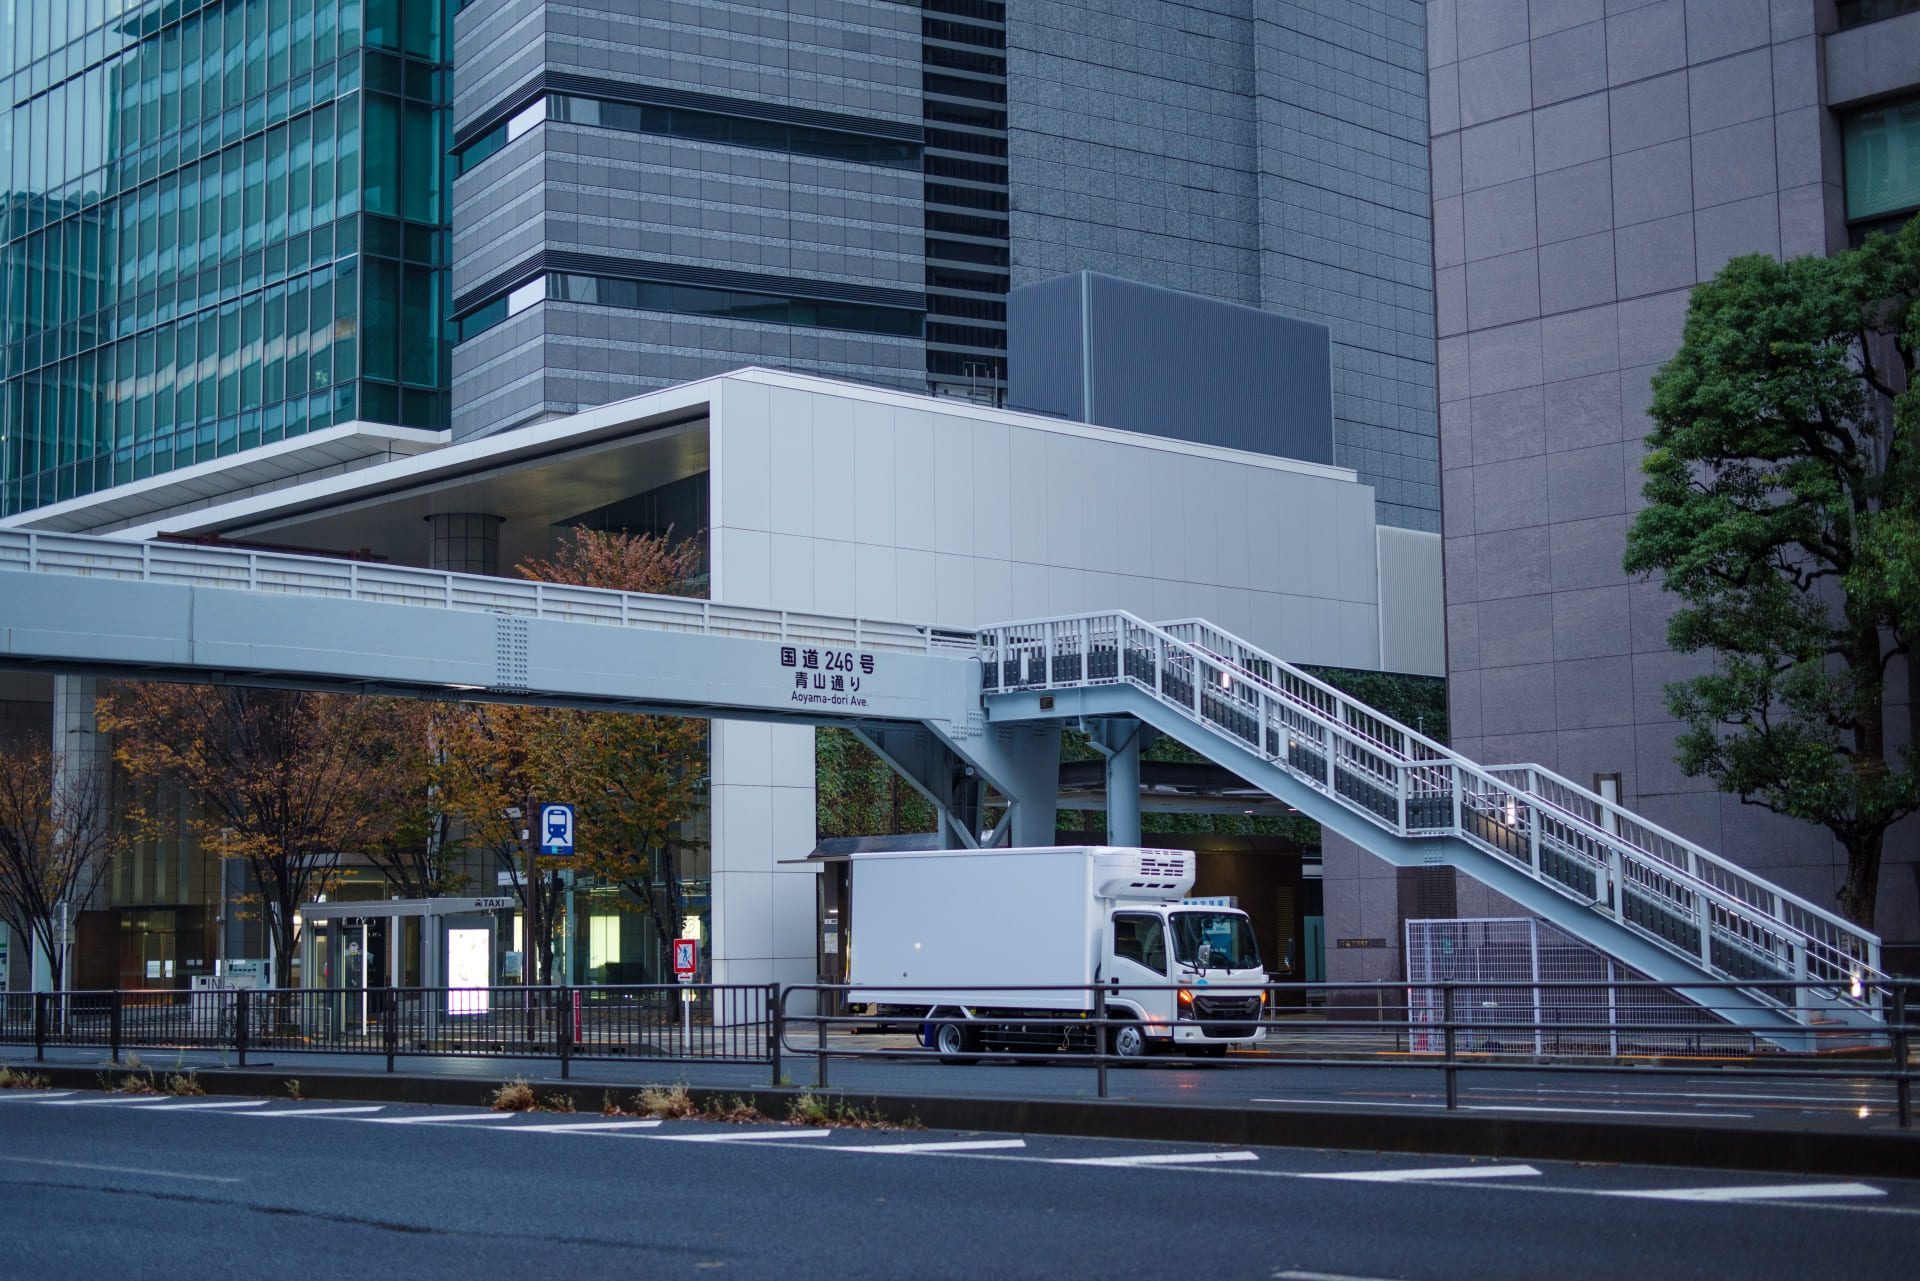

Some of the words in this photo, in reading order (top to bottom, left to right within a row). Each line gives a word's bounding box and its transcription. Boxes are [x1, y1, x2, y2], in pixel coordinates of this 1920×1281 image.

[781, 647, 875, 674] 国道246号
[795, 672, 860, 692] 青山通り
[791, 690, 848, 705] Aoyama-dori
[851, 695, 869, 707] Ave.
[484, 899, 505, 907] TAXI
